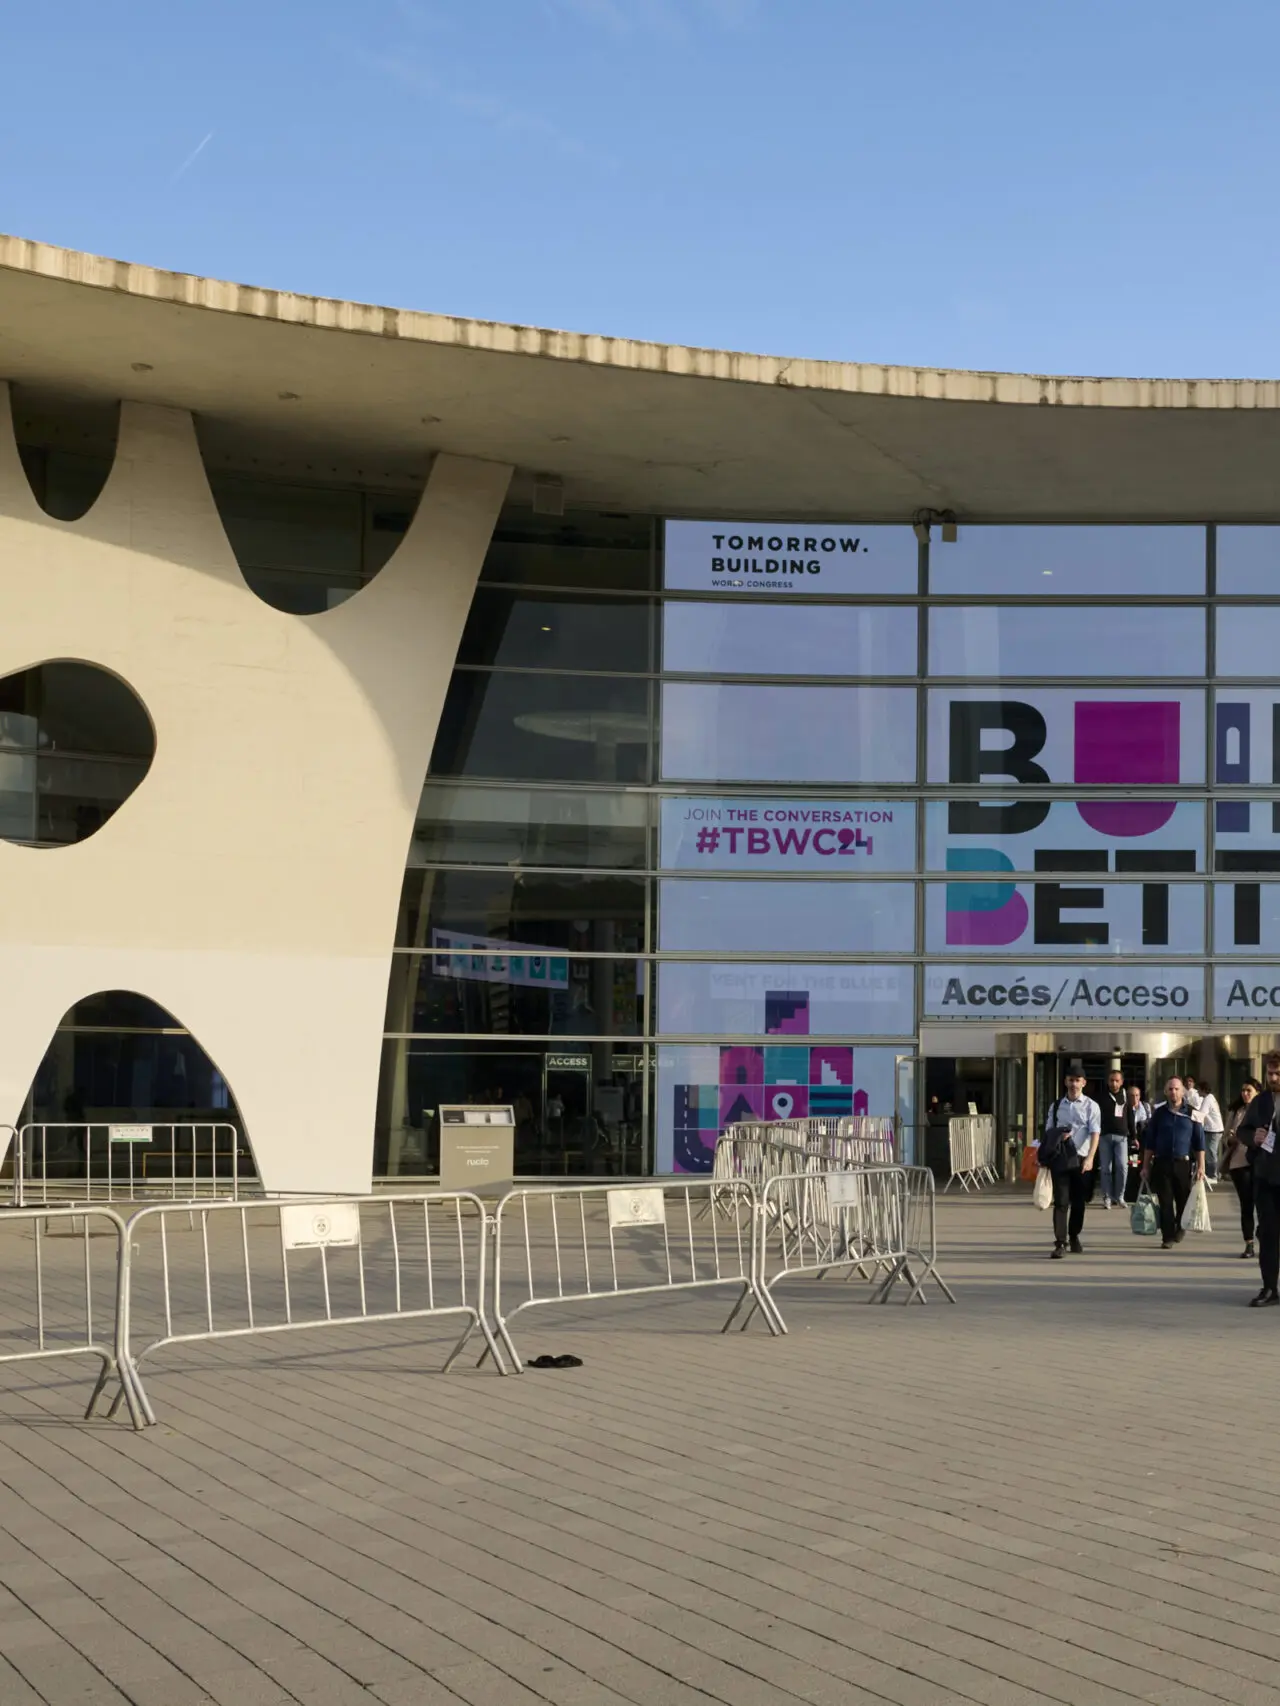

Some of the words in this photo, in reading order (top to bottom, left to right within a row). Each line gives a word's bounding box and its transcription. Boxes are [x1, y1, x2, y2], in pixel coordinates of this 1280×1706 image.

[711, 534, 869, 553] TOMORROW.
[711, 557, 821, 575] BUILDING
[746, 580, 794, 589] CONGRESS
[683, 808, 722, 821] JOIN
[727, 809, 759, 822] THE
[763, 810, 894, 823] CONVERSATION
[695, 826, 873, 856] #TBWC24
[548, 1056, 588, 1067] ACCESS
